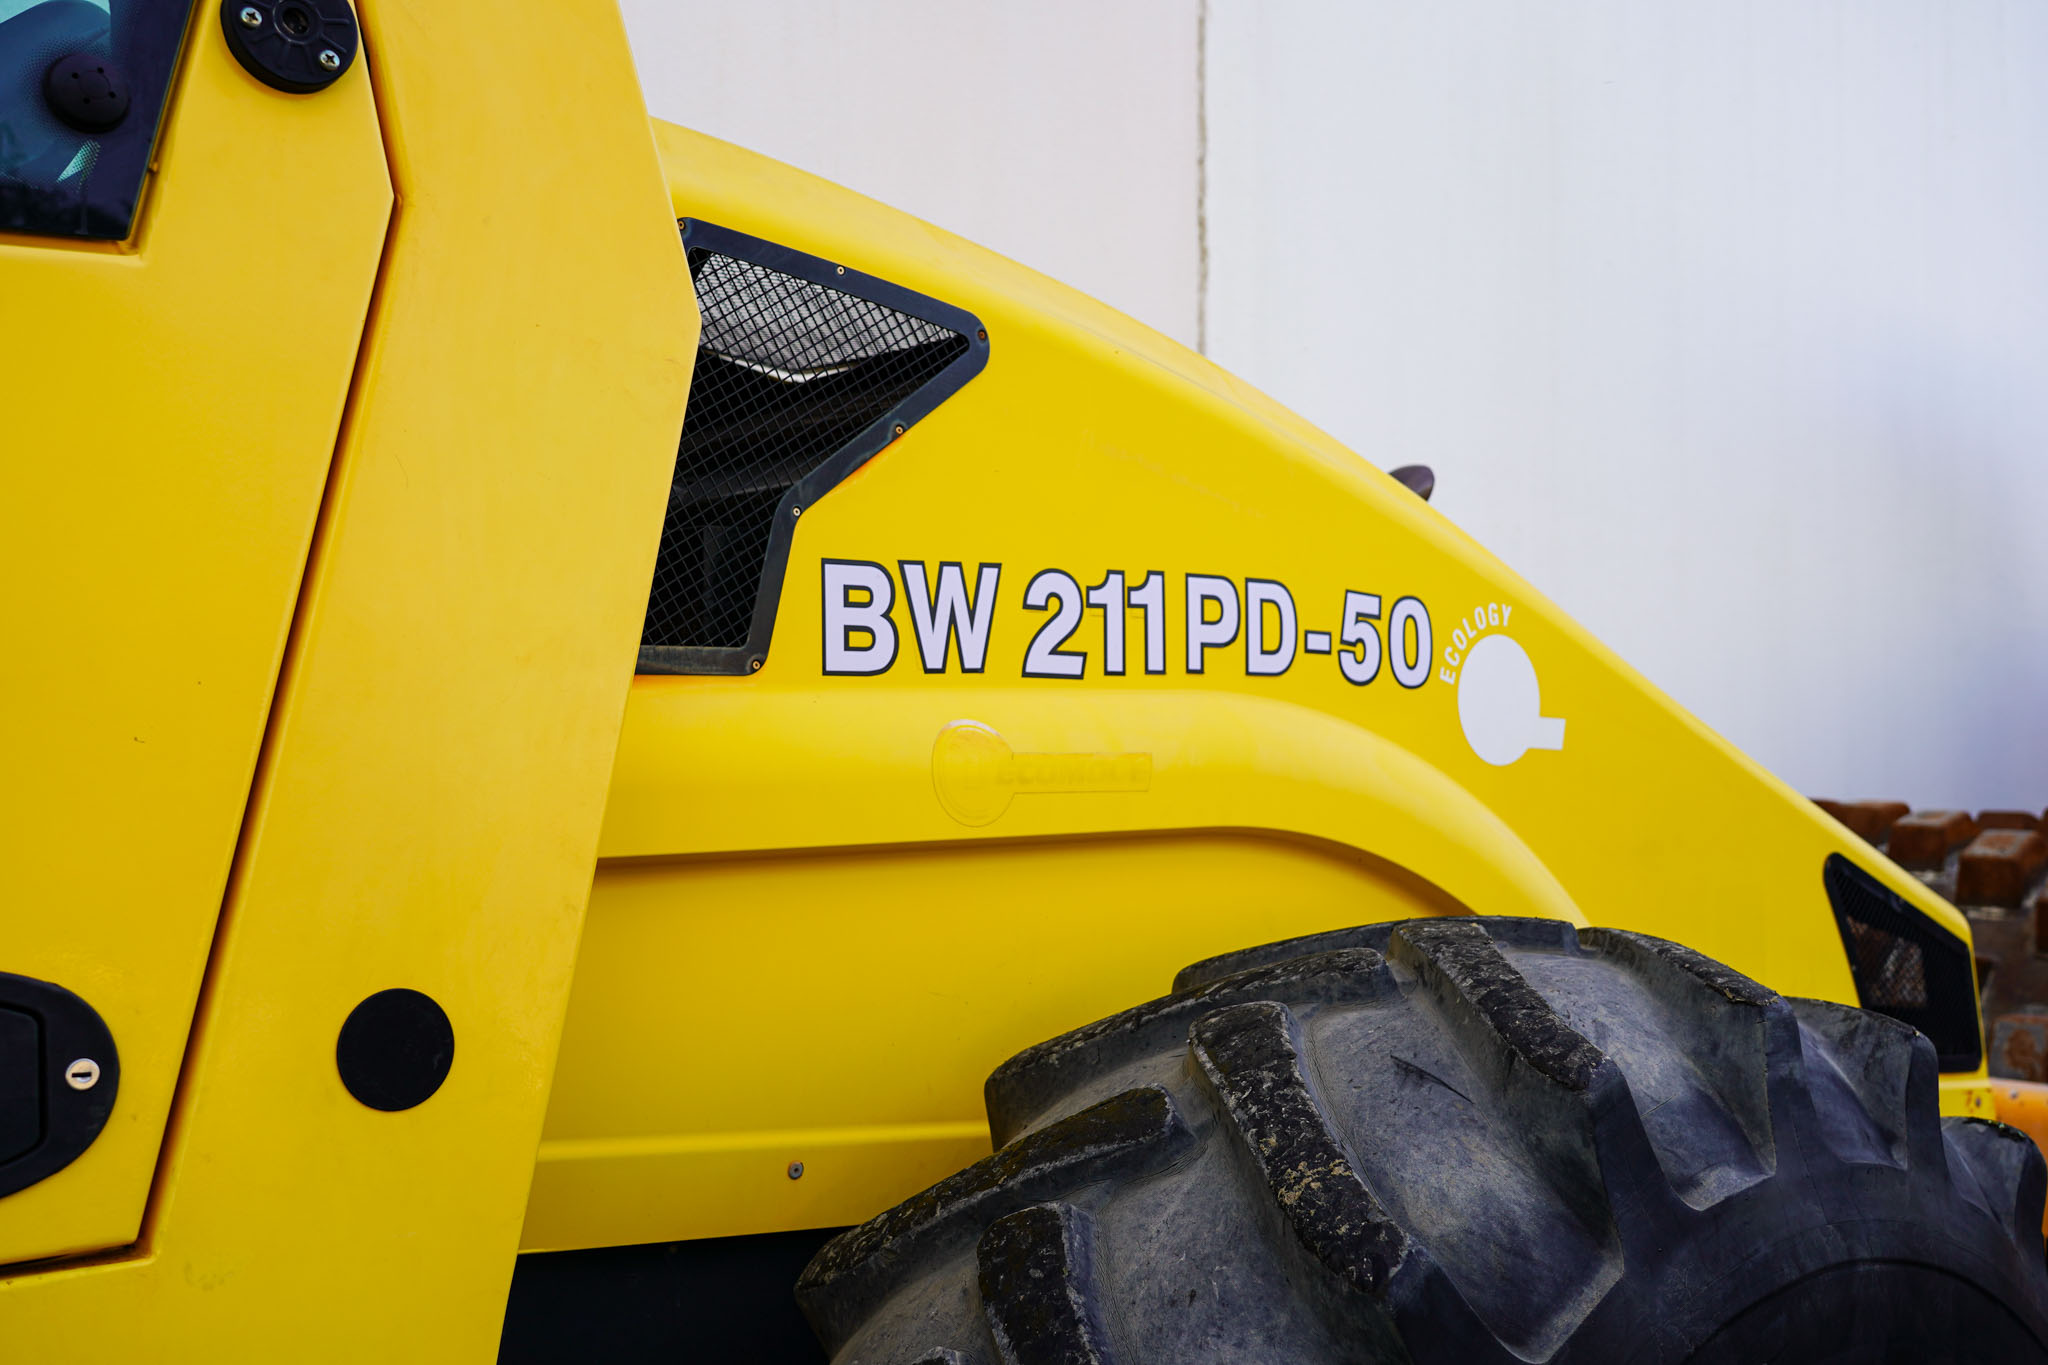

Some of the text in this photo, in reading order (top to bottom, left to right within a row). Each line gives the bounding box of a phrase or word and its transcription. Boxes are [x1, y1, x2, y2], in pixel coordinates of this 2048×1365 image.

[821, 558, 1433, 690] BW 211 PD-50
[1439, 602, 1513, 685] ECOLOGY
